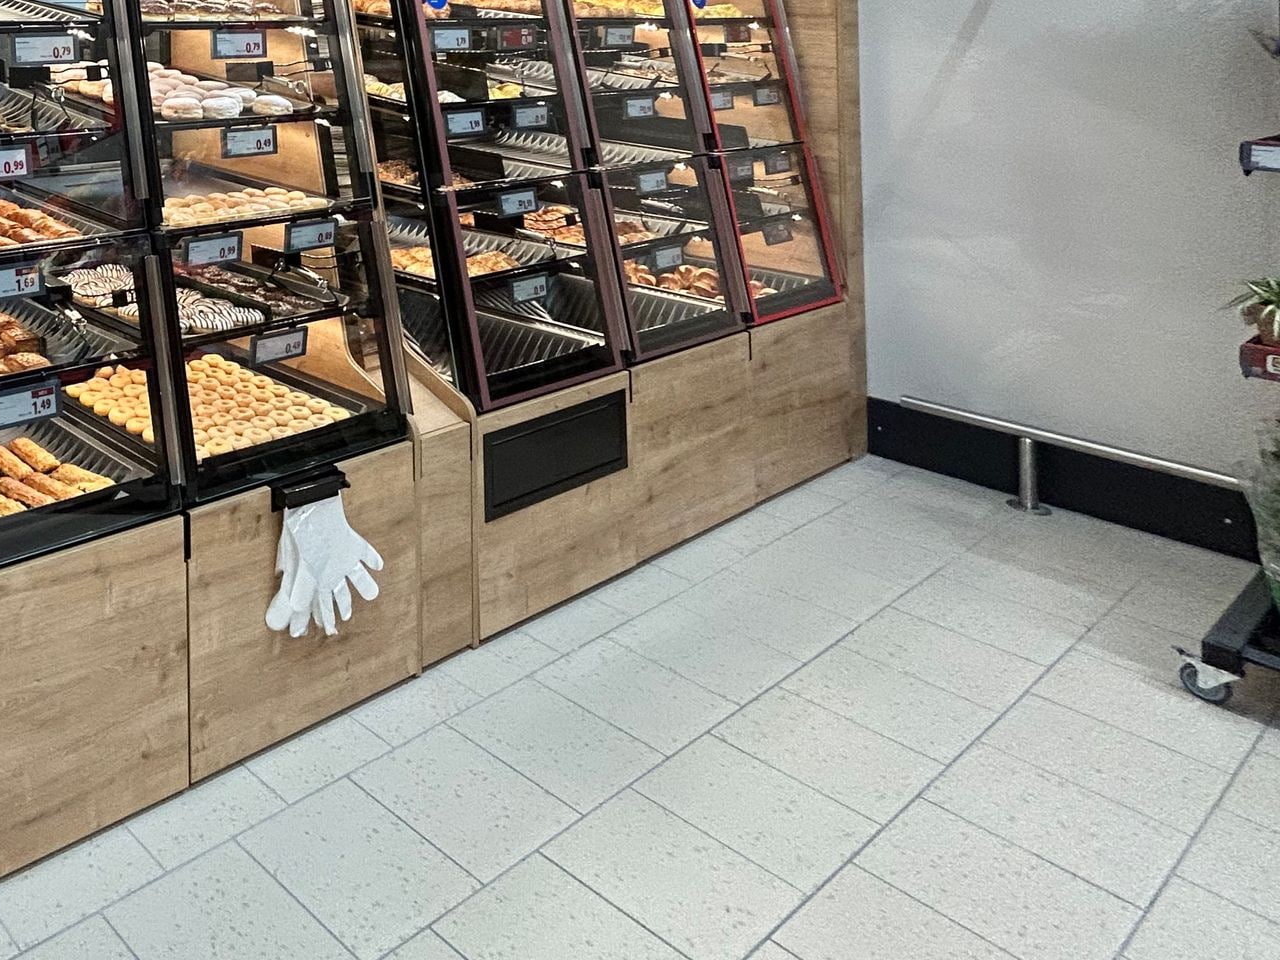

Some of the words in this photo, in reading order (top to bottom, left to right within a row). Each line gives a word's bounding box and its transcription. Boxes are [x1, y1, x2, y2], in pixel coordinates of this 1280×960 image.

[52, 46, 71, 59] 0.79
[245, 42, 261, 54] 0.79
[3, 159, 24, 174] 0.99
[15, 277, 35, 292] 1.69
[32, 398, 52, 415] 1.49
